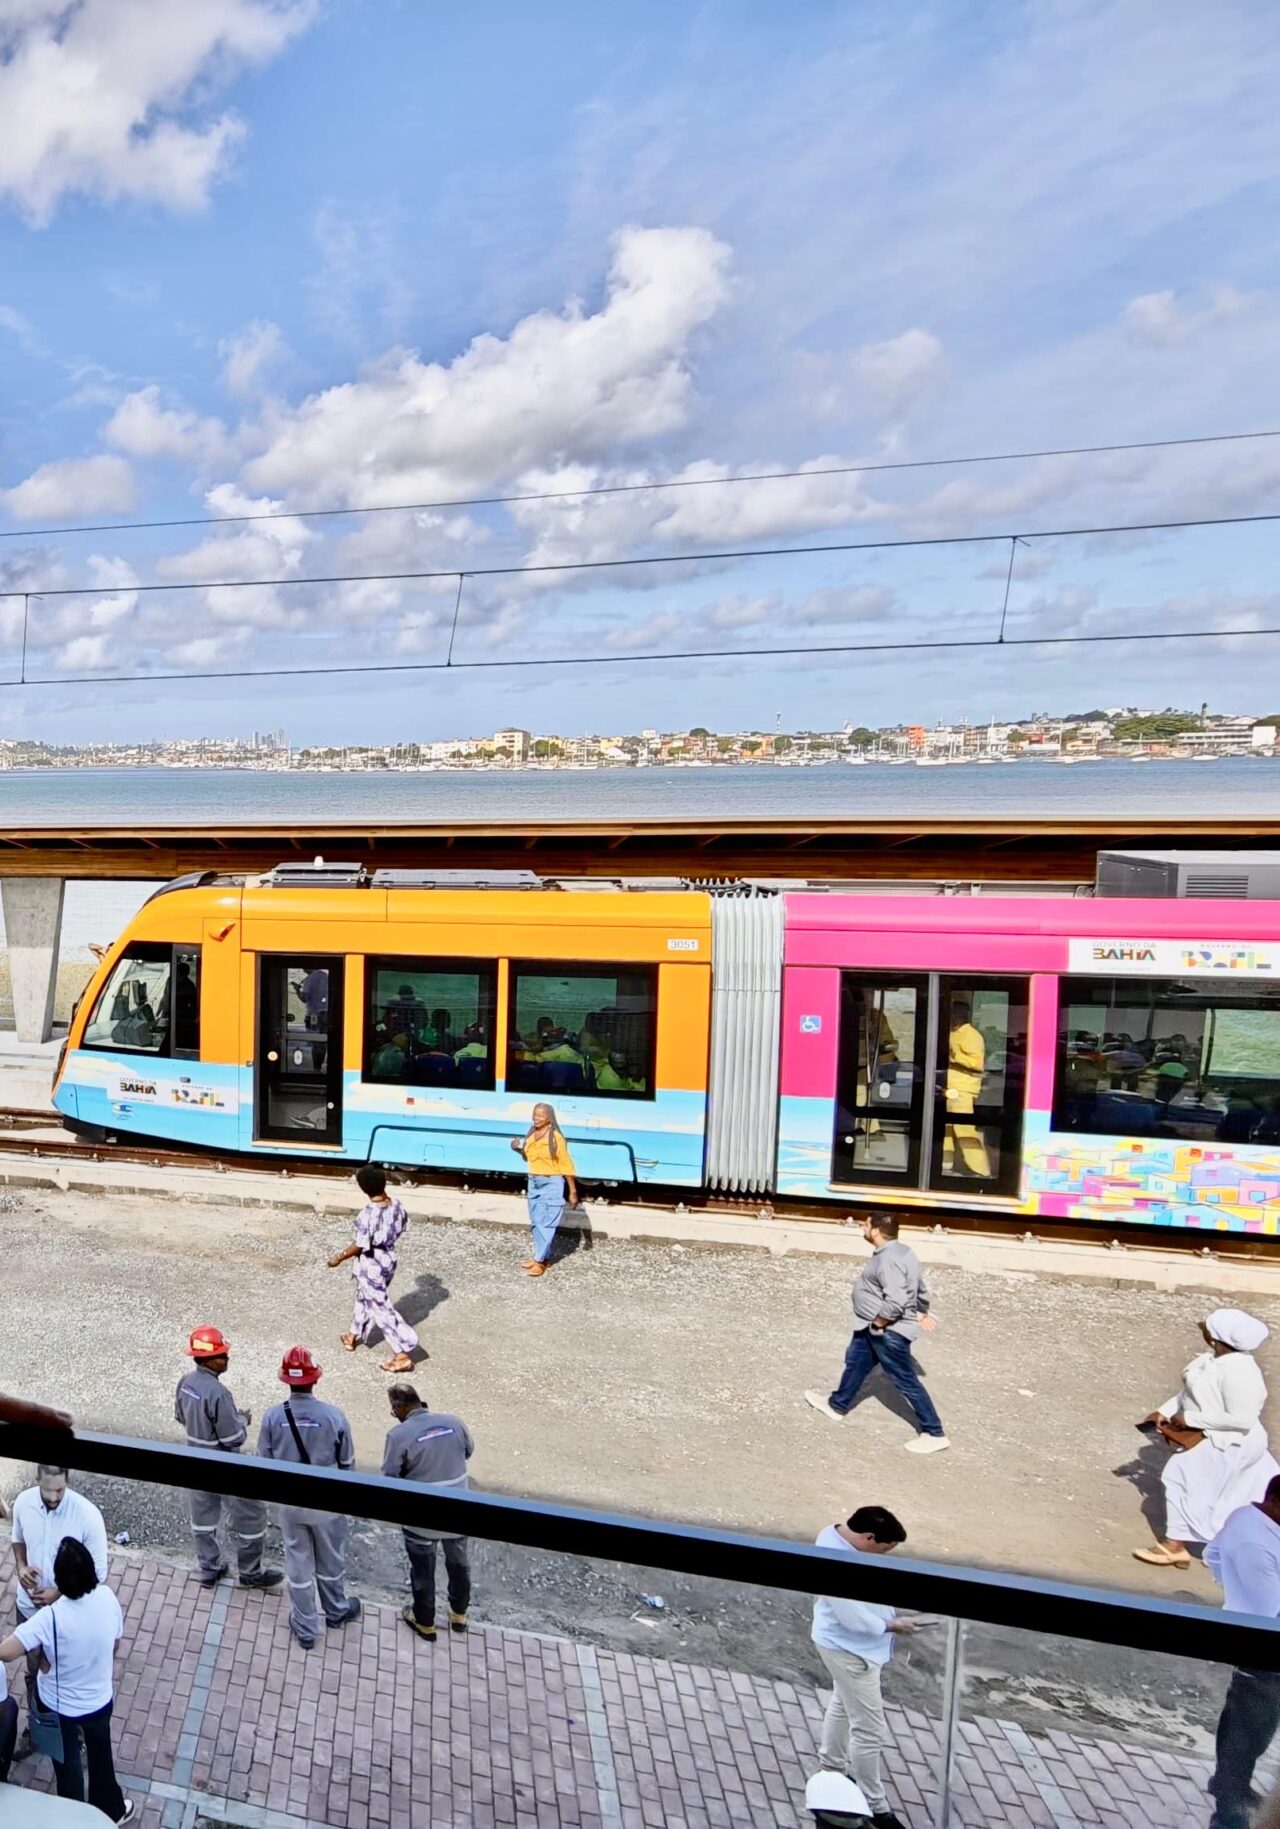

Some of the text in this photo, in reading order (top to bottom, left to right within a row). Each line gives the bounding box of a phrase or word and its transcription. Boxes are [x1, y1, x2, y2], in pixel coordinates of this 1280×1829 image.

[670, 940, 695, 949] 3051
[1092, 948, 1157, 961] BAHIA
[120, 1082, 157, 1095] BAHIA
